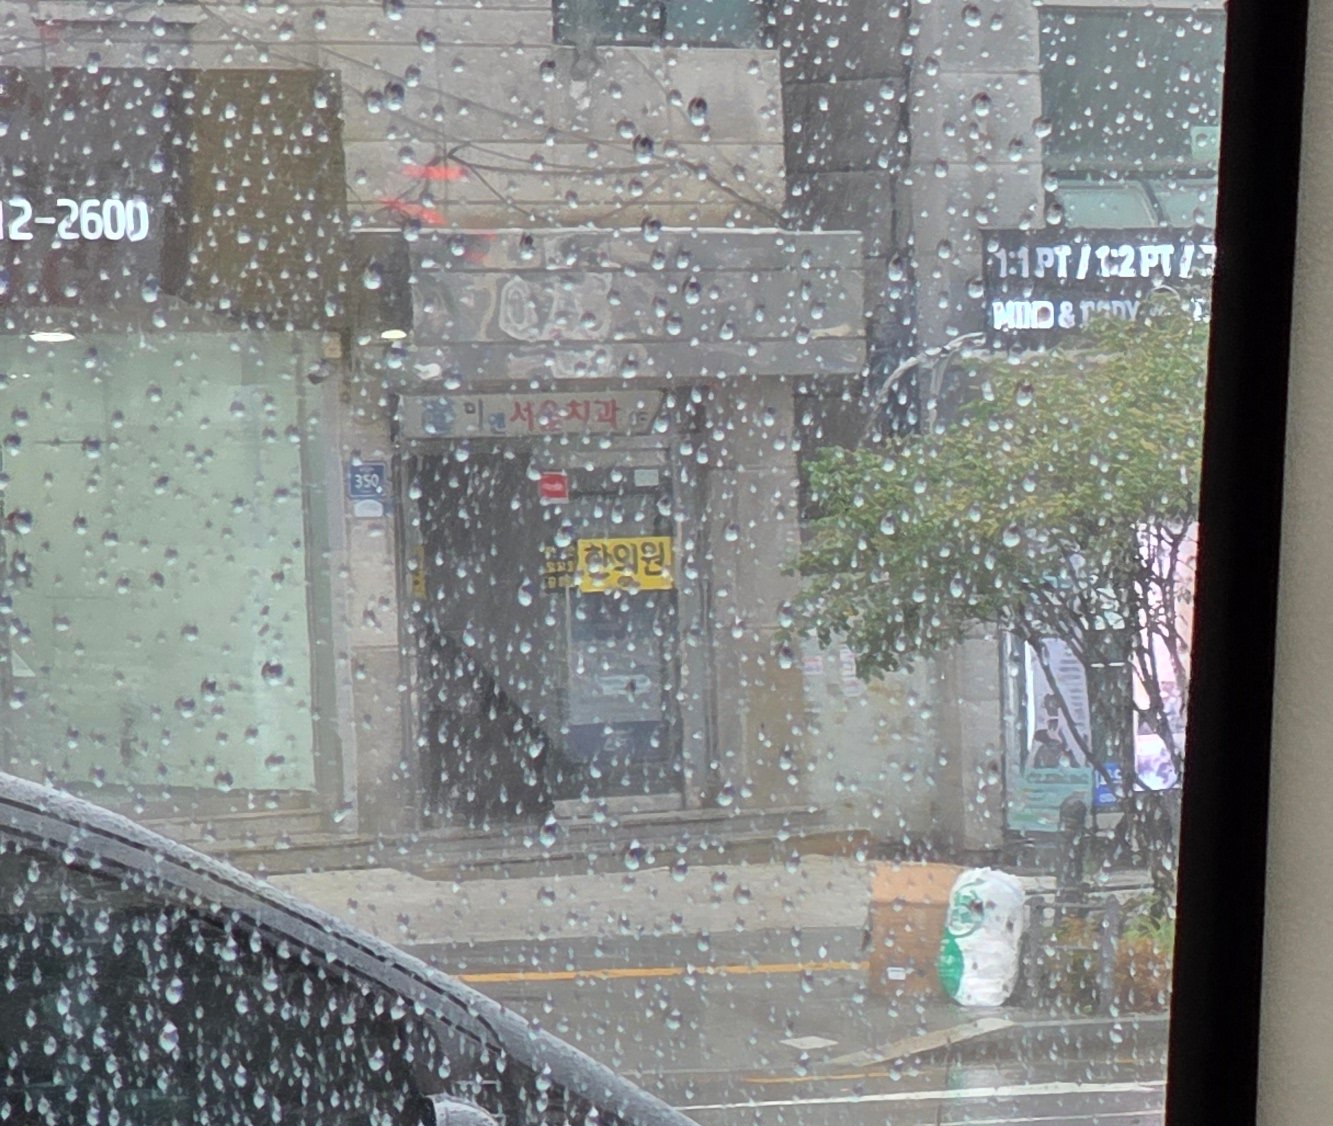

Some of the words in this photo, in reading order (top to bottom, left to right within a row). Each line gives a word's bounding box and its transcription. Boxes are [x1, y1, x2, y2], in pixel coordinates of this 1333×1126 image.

[1034, 245, 1071, 278] PT
[1139, 245, 1174, 277] PT
[1058, 301, 1075, 328] &
[354, 473, 380, 489] 350
[585, 541, 665, 580] 한의원
